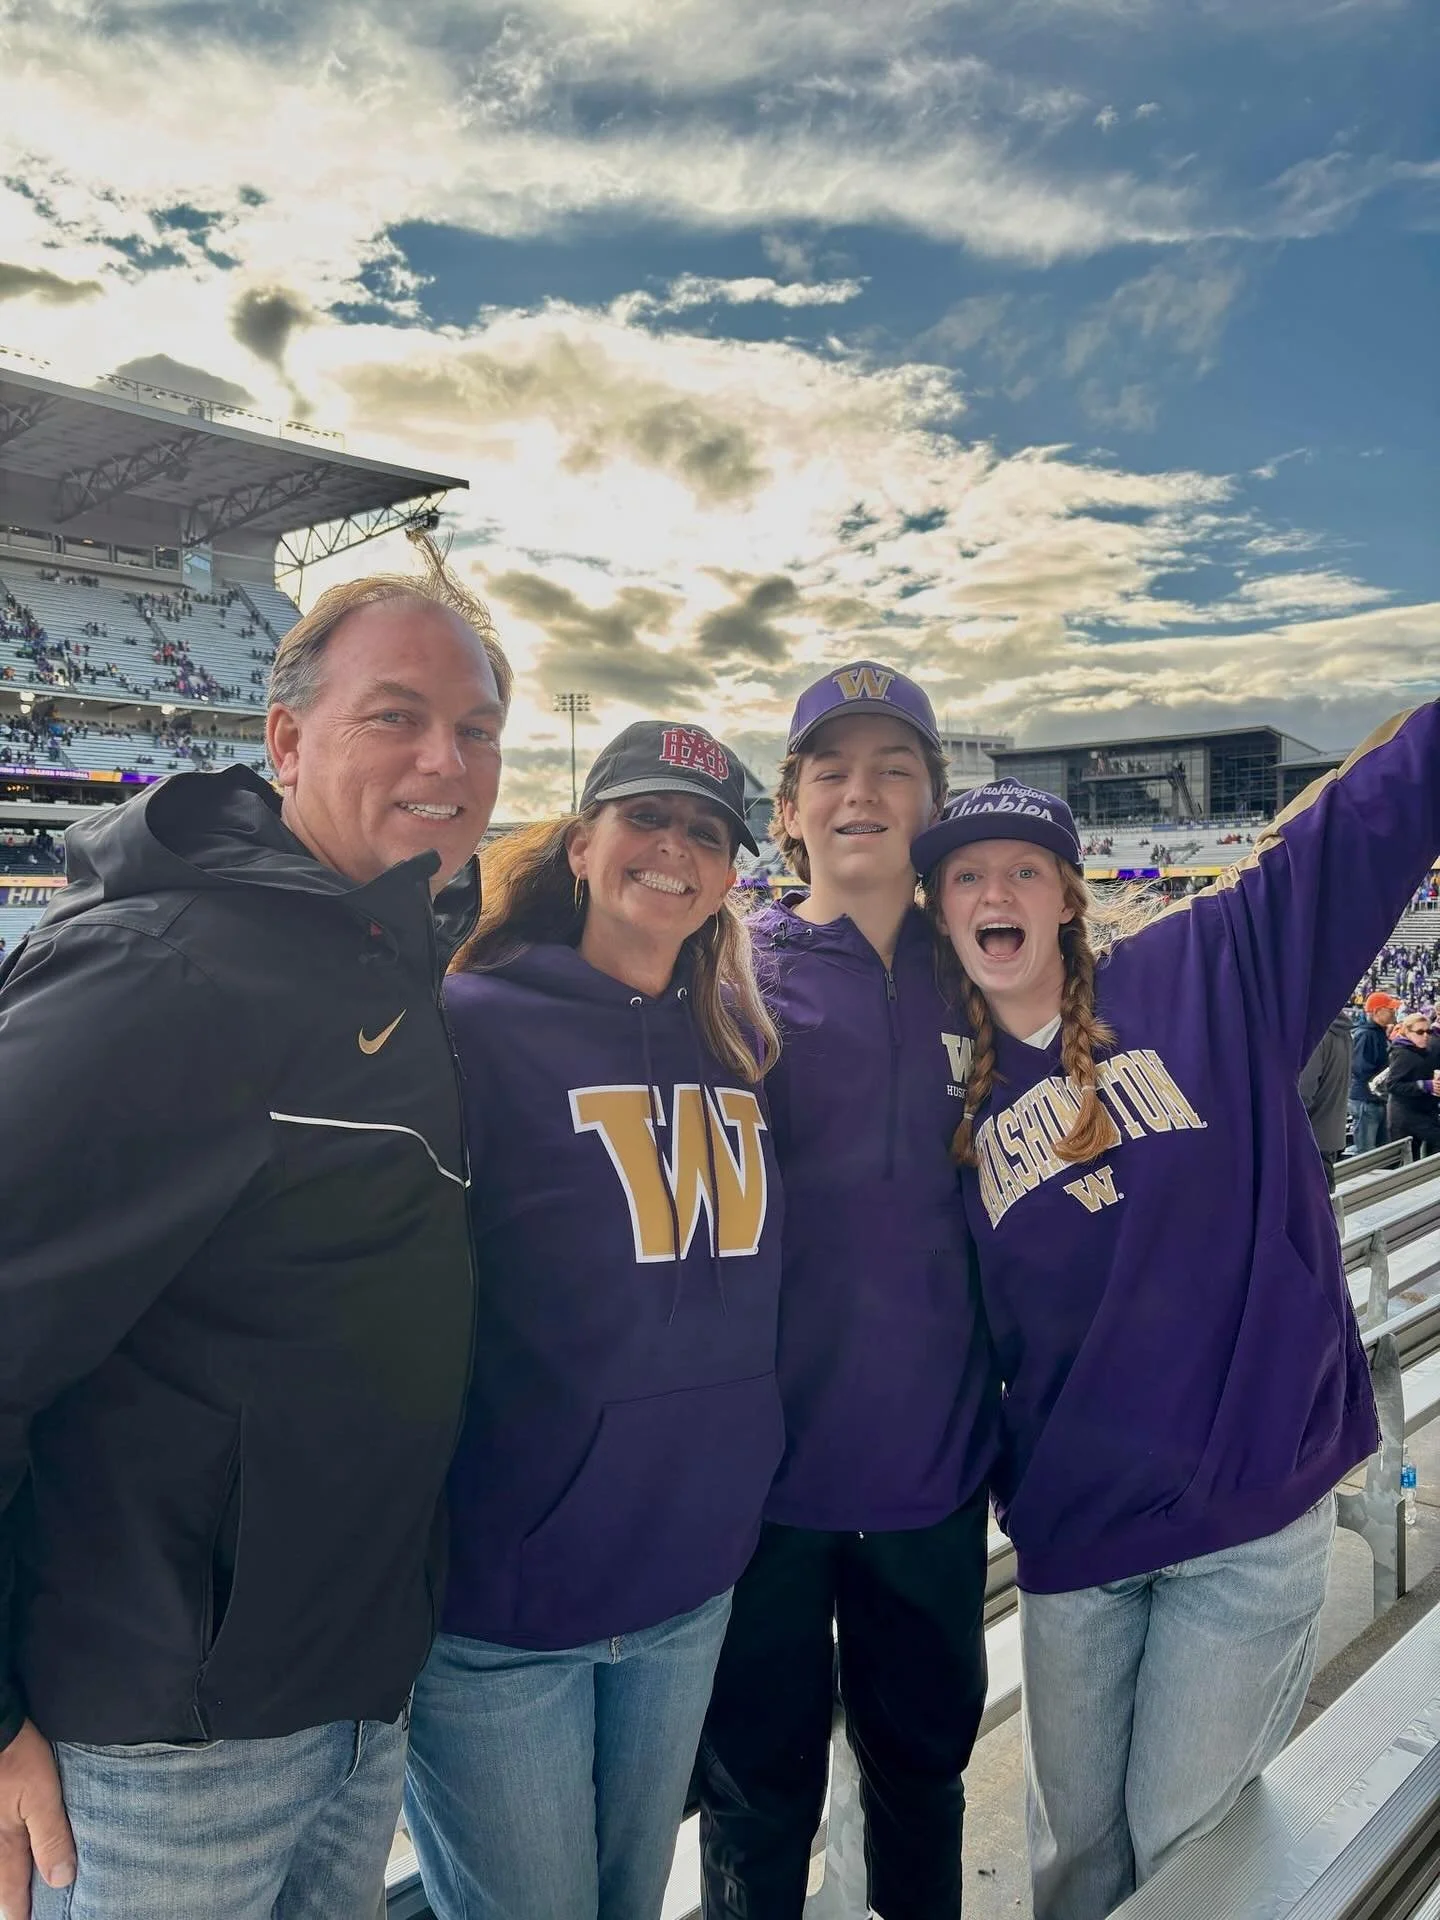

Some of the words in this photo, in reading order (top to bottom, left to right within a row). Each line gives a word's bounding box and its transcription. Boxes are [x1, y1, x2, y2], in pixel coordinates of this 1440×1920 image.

[832, 667, 896, 700] W
[972, 784, 1050, 803] Washington
[567, 1083, 768, 1264] W
[1062, 1165, 1119, 1213] W
